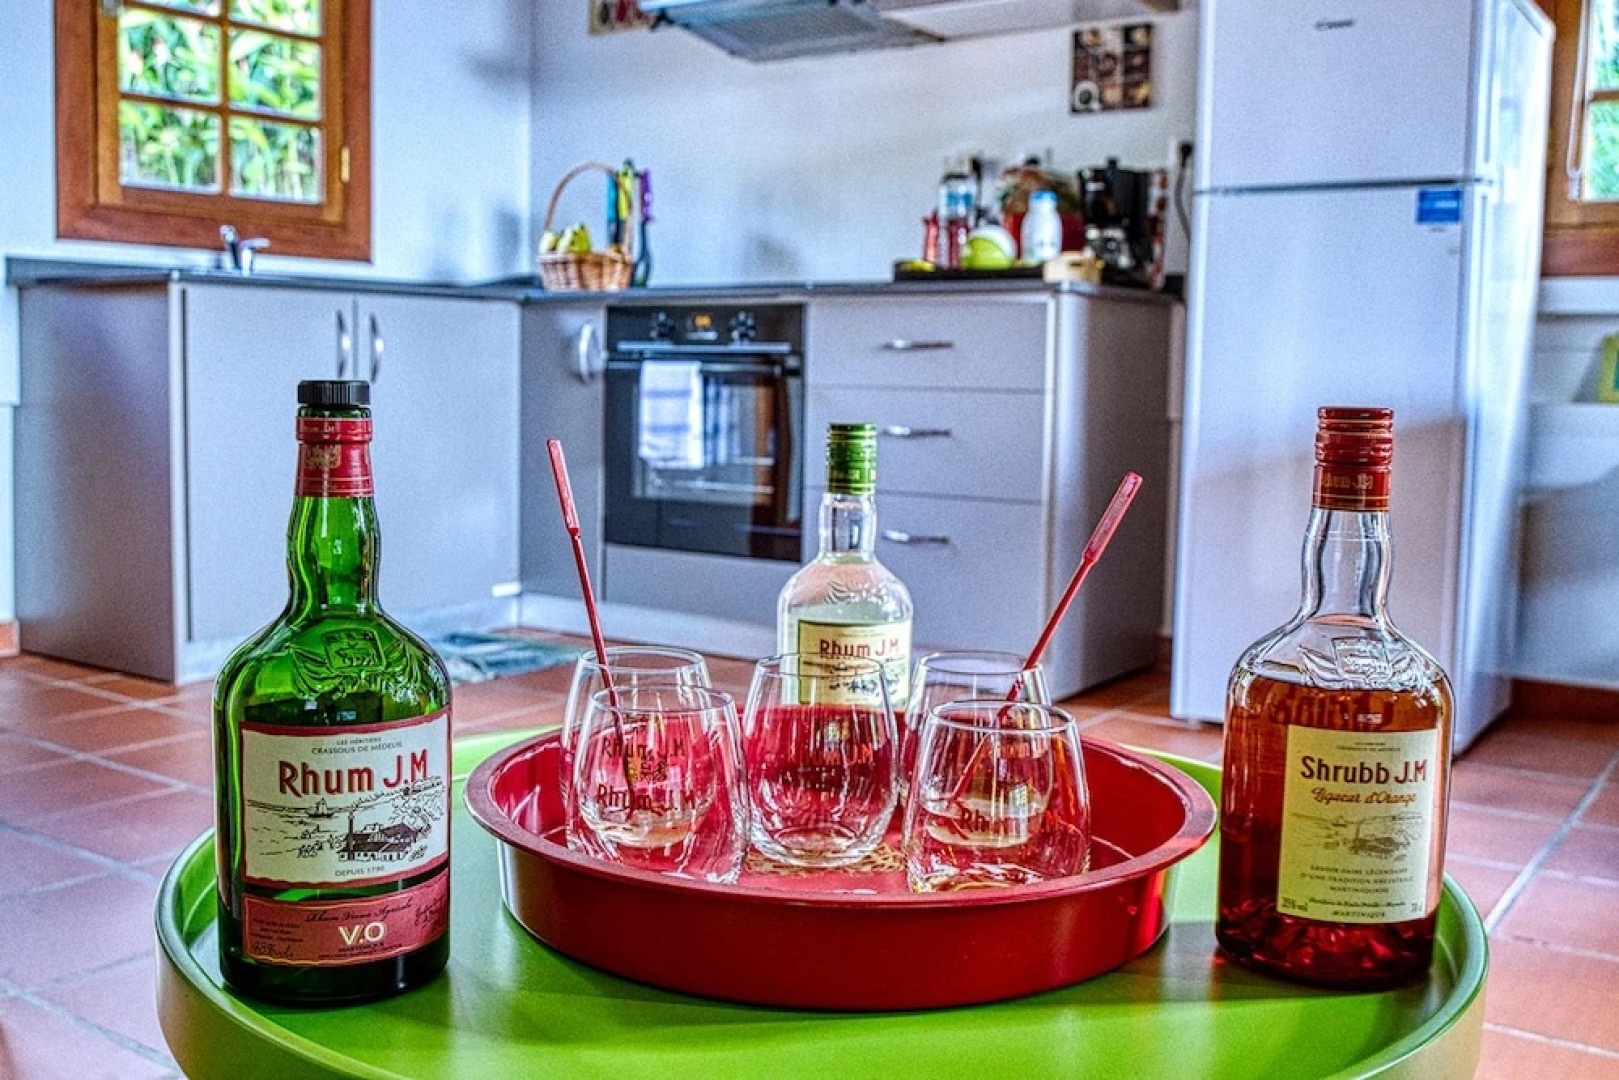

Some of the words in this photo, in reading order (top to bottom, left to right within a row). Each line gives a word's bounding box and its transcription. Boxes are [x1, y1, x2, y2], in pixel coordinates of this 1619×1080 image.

[820, 638, 870, 658] Rhum
[278, 759, 375, 798] Rhum
[383, 748, 429, 788] J.M
[1300, 755, 1390, 784] Shrubb
[1394, 759, 1427, 784] J.M
[335, 868, 366, 877] DEPUIS
[338, 920, 386, 946] V.O
